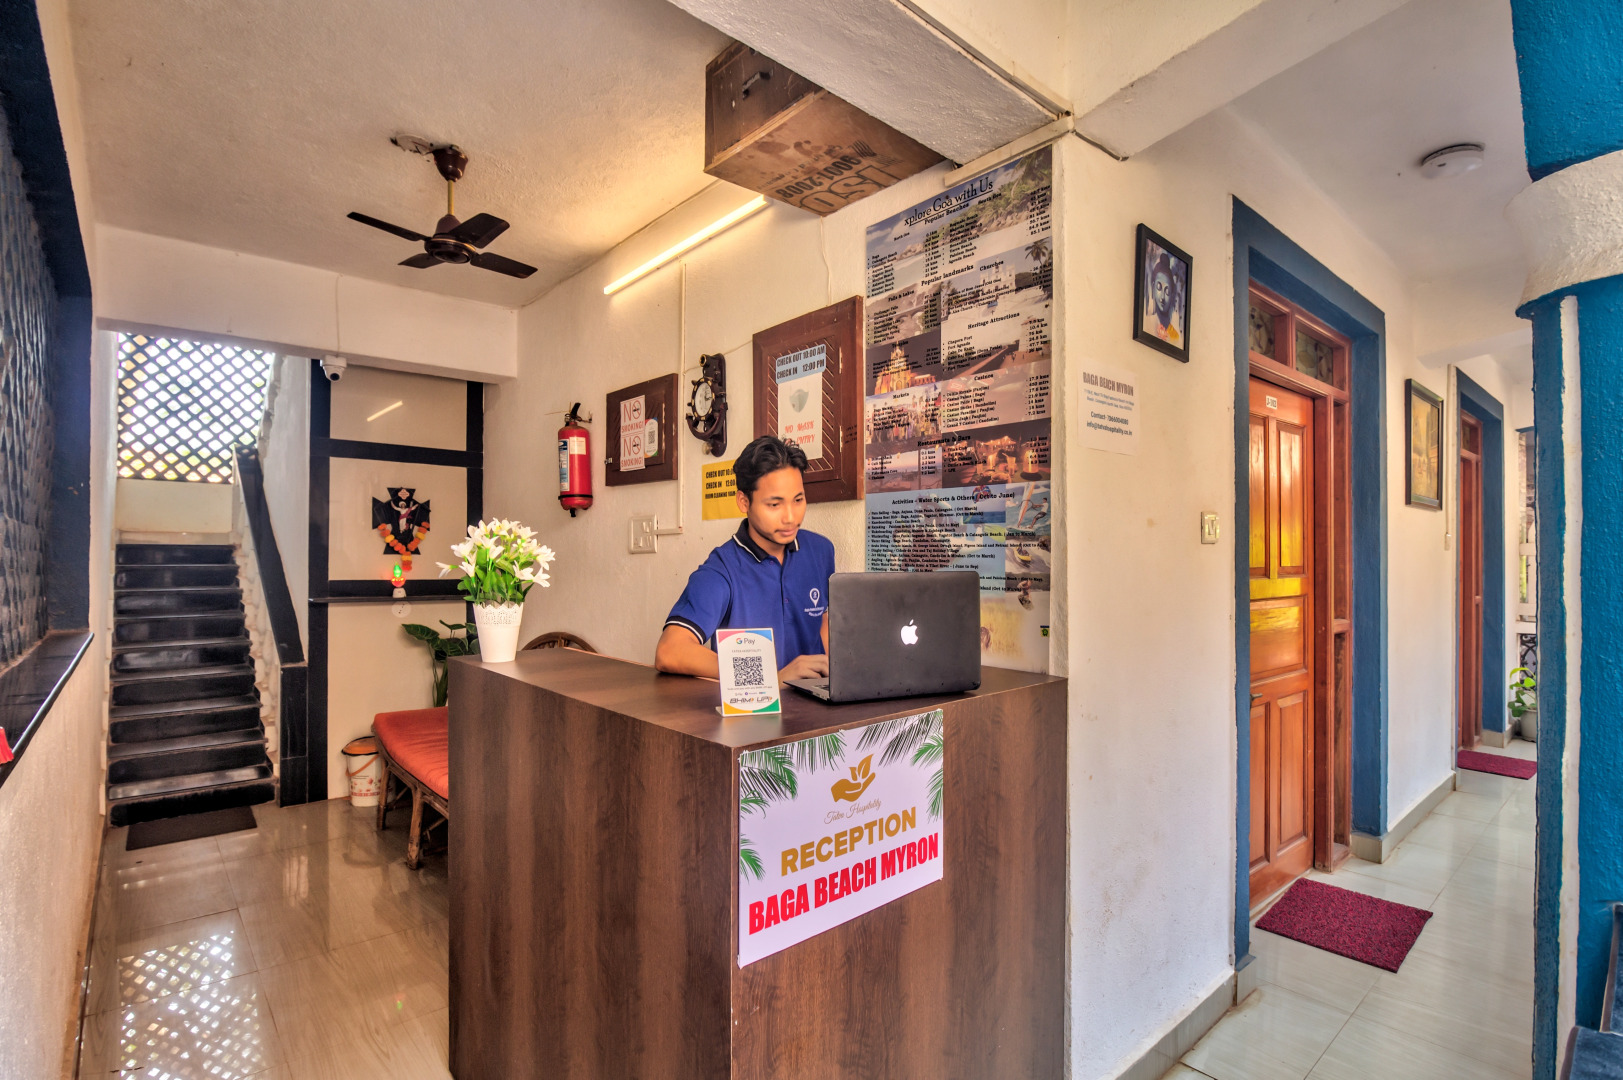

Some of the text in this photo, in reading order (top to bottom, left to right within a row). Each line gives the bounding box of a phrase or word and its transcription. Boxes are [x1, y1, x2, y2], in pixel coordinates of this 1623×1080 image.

[932, 197, 953, 212] Goa
[954, 184, 977, 203] with
[979, 177, 994, 193] Us
[924, 203, 970, 224] Popular Beaches
[979, 259, 1004, 272] Churches
[921, 264, 974, 286] Popular landmarks
[967, 310, 1020, 330] Heritage Attractions
[777, 345, 825, 367] CHECK OUT 10:00 AM
[777, 359, 824, 379] CHECK IN 12:00 PM
[974, 372, 994, 381] Casinos
[1083, 372, 1134, 396] BAGA BEACH MYRON
[622, 421, 644, 433] SMOKING!
[785, 420, 814, 433] NO MASK
[796, 434, 815, 445] ENTRY
[917, 437, 950, 446] Restaurants
[621, 456, 644, 467] SMOKING!
[706, 482, 717, 490] CHECK
[744, 638, 756, 646] Pay
[781, 806, 916, 877] RECEPTION
[749, 832, 938, 936] BAGA BEACH MYRON
